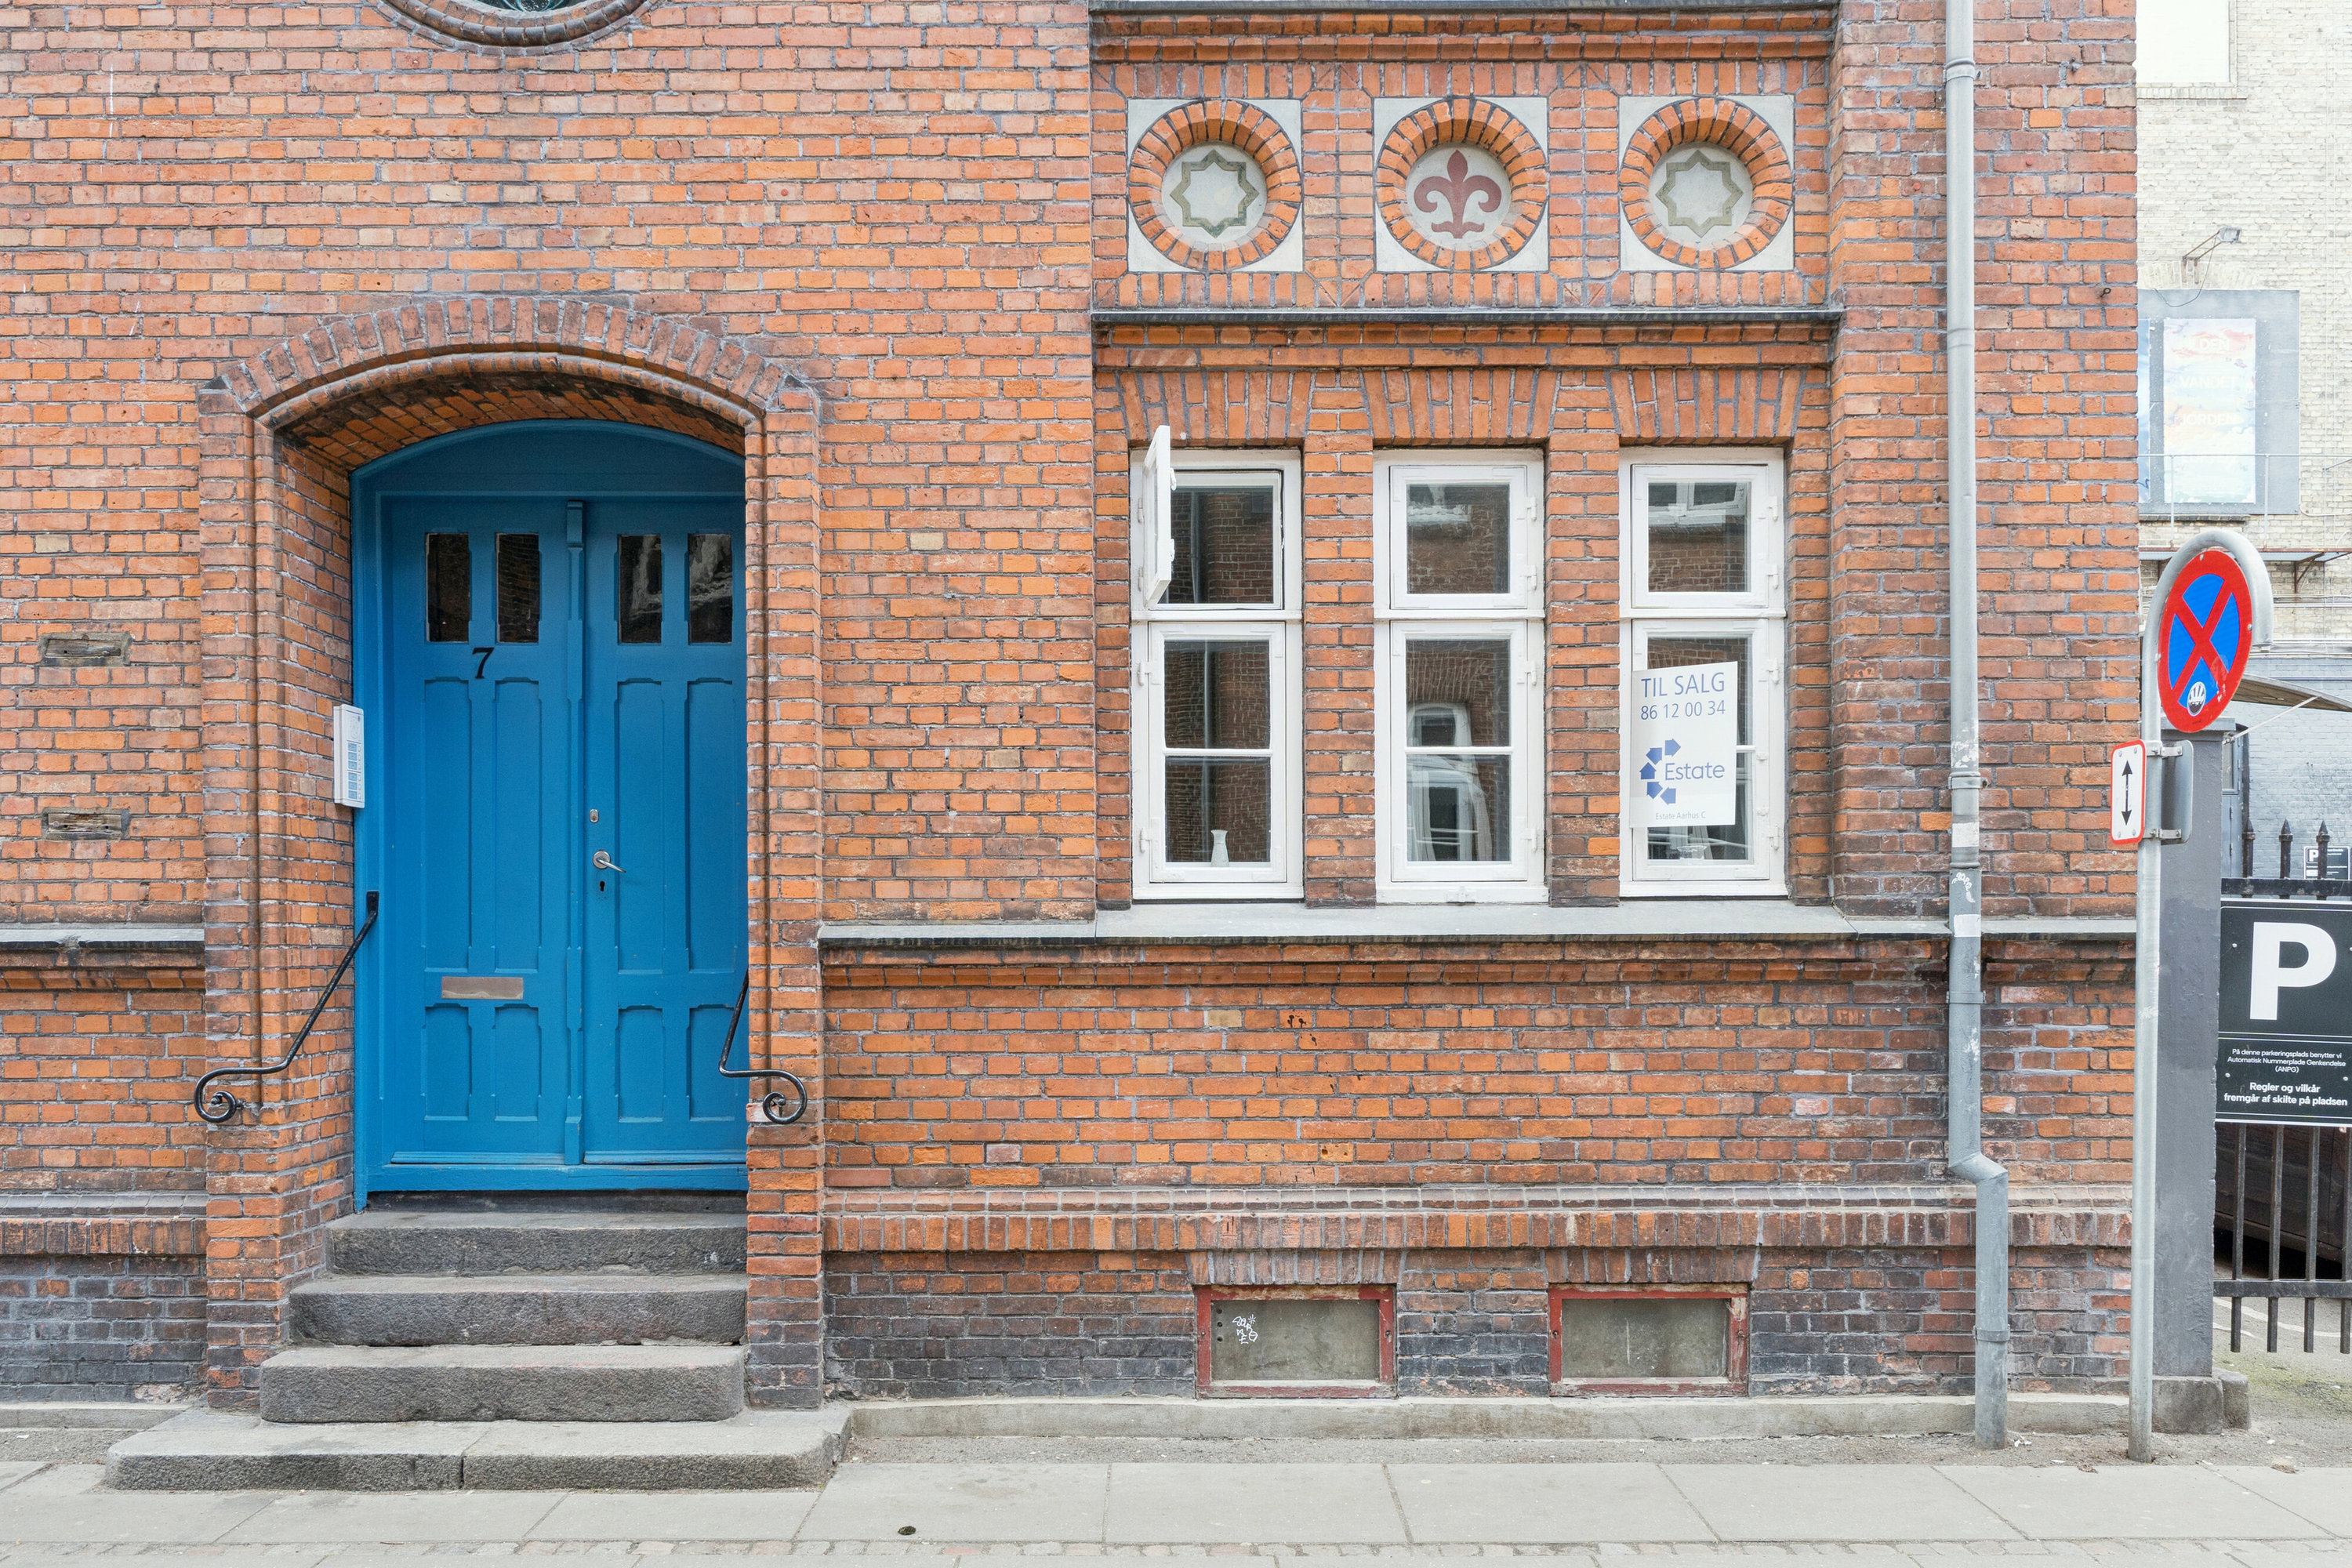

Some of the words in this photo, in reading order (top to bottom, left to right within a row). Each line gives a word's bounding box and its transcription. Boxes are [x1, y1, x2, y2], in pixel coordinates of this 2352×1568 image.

[2180, 376, 2236, 389] VANDET
[472, 647, 495, 679] 7
[1641, 677, 1668, 698] TIL
[1675, 672, 1724, 695] SALG
[1641, 705, 1657, 720] 86
[1664, 703, 1679, 718] 12
[1685, 702, 1702, 717] 00
[1708, 700, 1725, 715] 34
[1665, 762, 1725, 780] Estate
[2309, 849, 2319, 862] P
[2250, 922, 2336, 1020] P
[2261, 1050, 2309, 1058] parkeringsplads
[2249, 1082, 2279, 1092] Regler
[2281, 1085, 2294, 1094] og
[2296, 1083, 2321, 1093] vilkår
[2223, 1093, 2259, 1104] fremgår
[2261, 1094, 2270, 1103] af
[2272, 1094, 2297, 1104] skilte
[2299, 1096, 2310, 1105] på
[2312, 1096, 2348, 1106] pladsen
